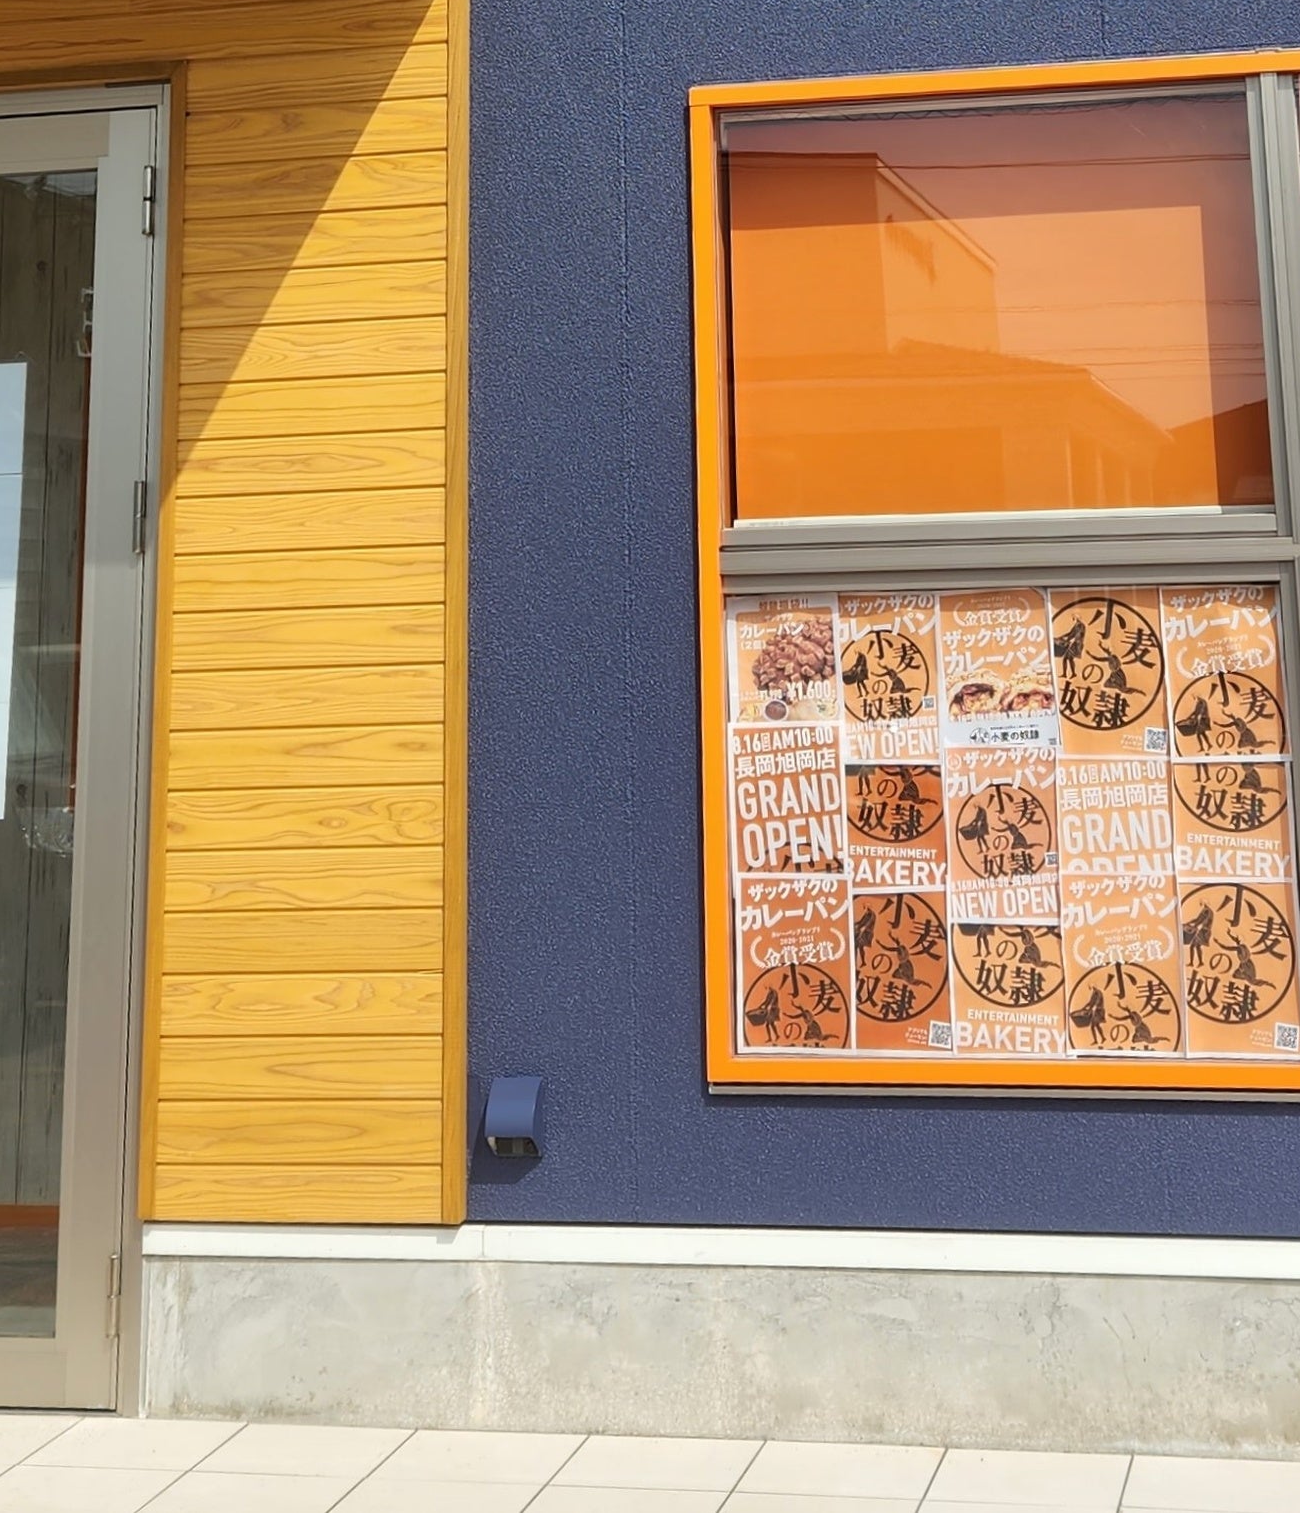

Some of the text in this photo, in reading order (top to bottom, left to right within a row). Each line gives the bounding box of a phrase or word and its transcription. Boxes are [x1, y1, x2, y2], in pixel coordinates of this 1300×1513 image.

[845, 595, 933, 616] ザックザクの
[1170, 587, 1263, 613] ザックザクの
[740, 622, 804, 638] カレーパン
[944, 625, 1044, 648] ザックザクの
[1088, 599, 1158, 668] 小麦
[1164, 606, 1280, 643] カレーパン
[945, 647, 1050, 674] カレーパン
[1082, 664, 1103, 683] の
[1060, 680, 1130, 727] 奴隷
[885, 727, 939, 758] OPEN!
[1216, 731, 1235, 748] の
[735, 747, 836, 779] 長岡旭岡店
[963, 748, 1055, 769] ザックザクの
[877, 778, 897, 798] の
[947, 765, 1056, 798] カレーパン
[1216, 766, 1238, 786] の
[737, 772, 840, 820] GRAND
[1060, 785, 1167, 811] 長岡旭岡店
[1195, 785, 1266, 830] 奴隷
[857, 798, 925, 840] 奴隷
[1063, 809, 1171, 855] GRAND
[742, 814, 844, 868] OPEN!
[850, 845, 937, 859] ENTERTAINMENT
[1187, 833, 1280, 850] ENTERTAINMENT
[1176, 845, 1290, 877] BAKERY
[748, 879, 837, 902] ザックザクの
[1069, 875, 1165, 899] ザックザクの
[741, 897, 848, 931] カレーパン
[951, 885, 1058, 918] NEW OPEN
[1063, 893, 1178, 929] カレーパン
[1217, 886, 1290, 961] 小麦
[764, 941, 835, 968] 金賞受賞
[871, 953, 892, 973] の
[996, 940, 1017, 960] の
[1210, 953, 1232, 974] の
[779, 964, 841, 1016] 小麦
[975, 959, 1046, 1005] 奴隷
[1104, 962, 1172, 1017] 小麦
[1187, 970, 1259, 1021] 奴隷
[784, 1022, 801, 1040] の
[967, 1009, 1059, 1026] ENTERTAINMENT
[955, 1021, 1066, 1053] BAKERY
[1110, 1024, 1130, 1043] の
